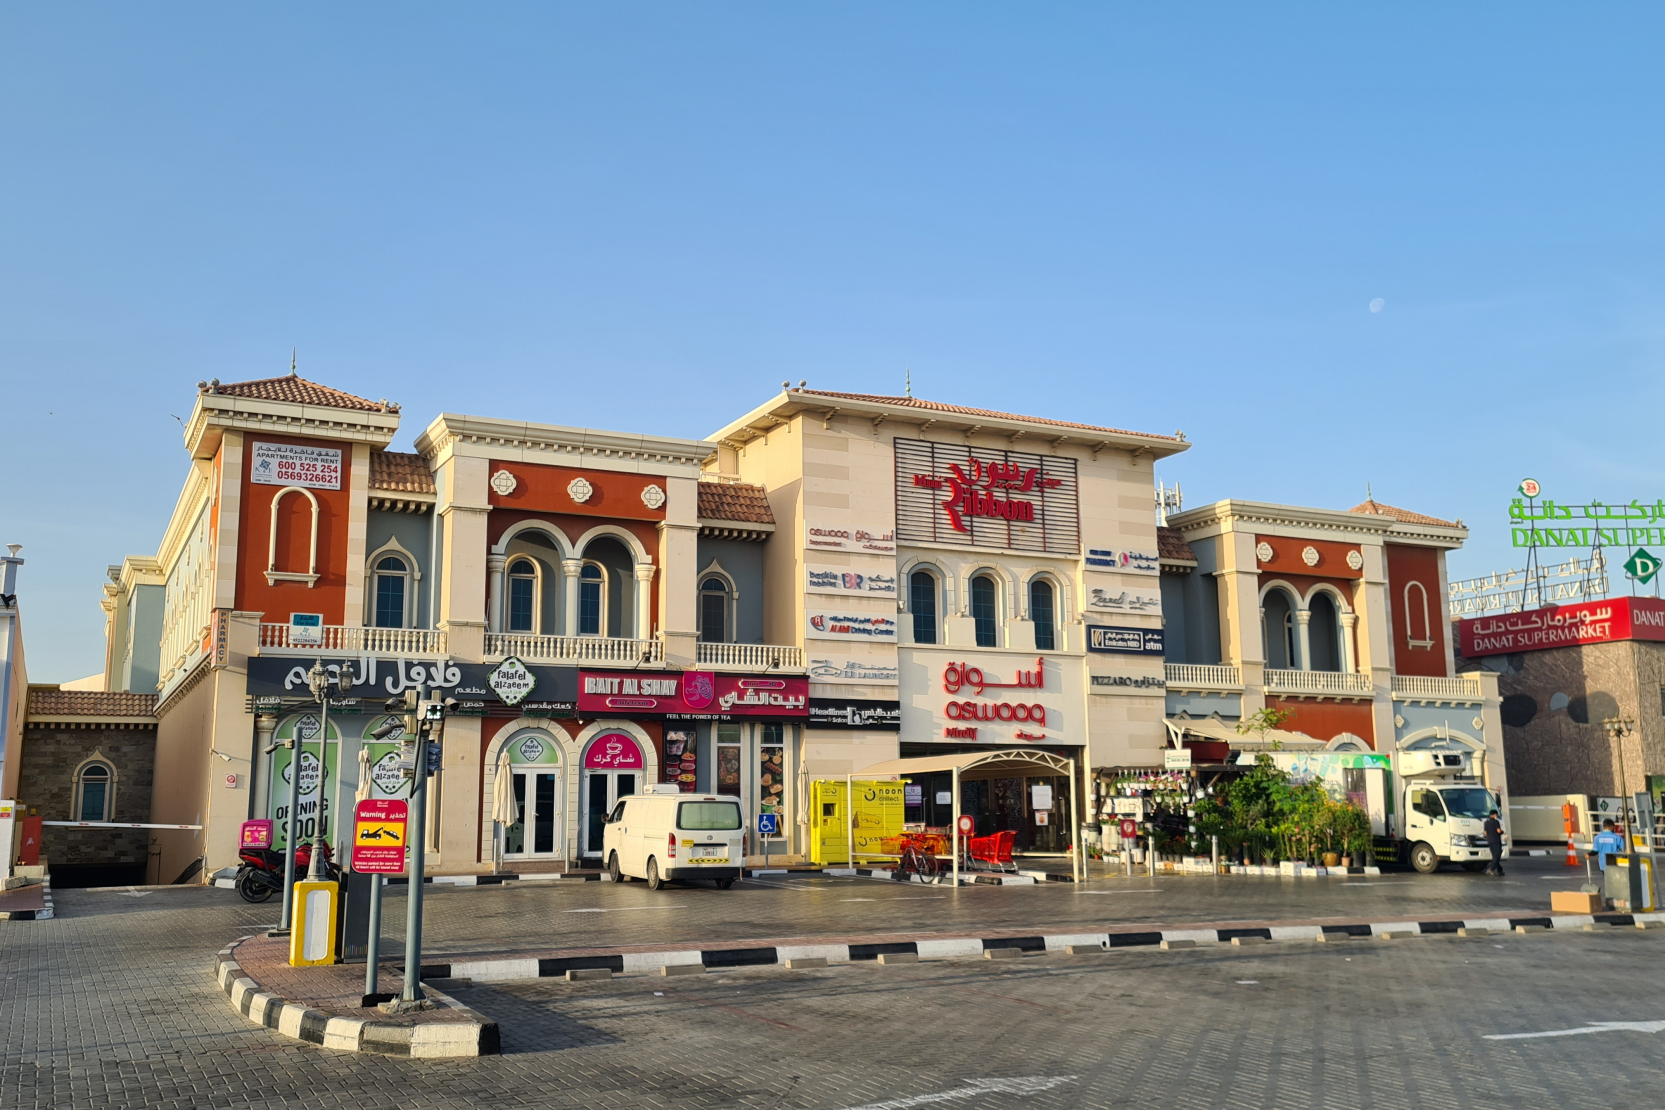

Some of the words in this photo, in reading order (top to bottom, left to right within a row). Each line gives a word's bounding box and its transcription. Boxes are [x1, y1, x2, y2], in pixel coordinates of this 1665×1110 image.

[256, 452, 302, 461] APARTMENTS
[278, 460, 296, 470] 600
[300, 462, 318, 472] 525
[320, 464, 338, 474] 254
[277, 470, 338, 484] 0569326621
[1525, 484, 1537, 492] 24
[941, 477, 1035, 533] Ribbon
[1508, 498, 1573, 520] دانة
[809, 528, 850, 540] aswaaq
[855, 530, 894, 542] أسواق
[1511, 527, 1594, 547] DANAT
[809, 539, 842, 547] Supermarket
[1086, 558, 1116, 567] PHARMACY
[809, 571, 838, 580] baskin
[809, 580, 836, 588] robbins
[1506, 607, 1612, 630] سوبرماركت
[851, 627, 872, 635] Driving
[874, 628, 894, 636] Center
[1472, 619, 1505, 634] دانة
[218, 612, 227, 662] PHARMACY
[1474, 634, 1514, 652] DANAT
[1518, 622, 1611, 646] SUPERMARKET
[1145, 642, 1162, 650] atm
[385, 657, 462, 694] فلافل
[498, 670, 526, 681] falafel
[858, 672, 897, 680] LAUNDRY
[943, 656, 1045, 696] أسواق
[1090, 676, 1132, 686] PIZZARO
[455, 686, 486, 694] مطعم
[494, 680, 530, 690] alzaeem
[584, 677, 620, 694] BAIT
[622, 678, 640, 695] AL
[640, 679, 678, 696] SHAY
[718, 689, 767, 711] الشاي
[769, 694, 805, 710] بيت
[813, 708, 848, 716] Headlines
[944, 701, 1046, 727] aswaaq
[593, 754, 611, 764] كرك
[613, 753, 635, 767] شاي
[276, 798, 329, 820] OPNING
